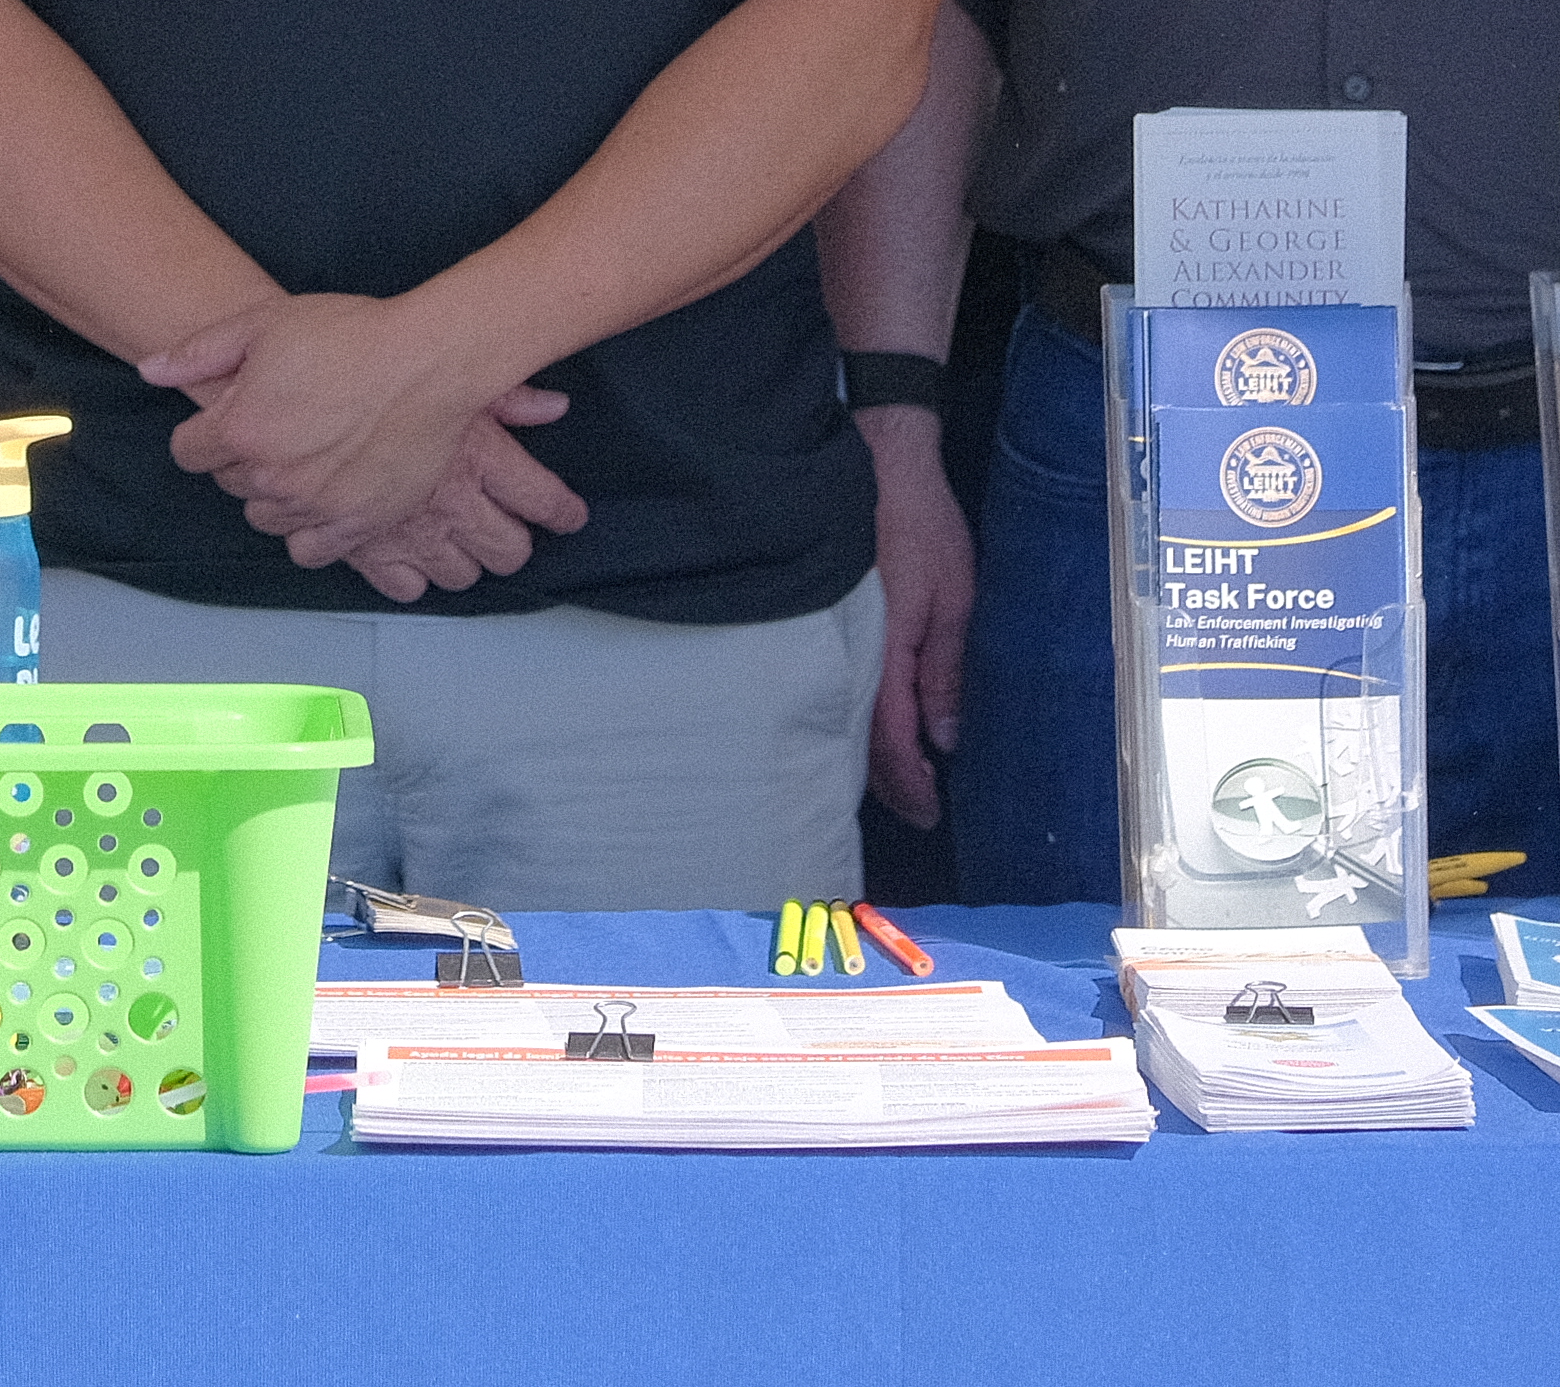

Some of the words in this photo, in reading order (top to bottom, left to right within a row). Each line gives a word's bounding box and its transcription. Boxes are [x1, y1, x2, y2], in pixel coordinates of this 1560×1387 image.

[1171, 197, 1347, 221] KATHARINE
[1169, 229, 1192, 253] &
[1209, 229, 1347, 252] GEORGE
[1172, 259, 1346, 283] ALEXANDER
[1171, 288, 1350, 308] COMMUNITY
[1165, 547, 1259, 575] LEIHT
[1165, 582, 1240, 610] Task
[1247, 582, 1335, 610] Force
[1165, 615, 1195, 630] Law
[1197, 614, 1288, 631] Enforcement
[1291, 614, 1384, 630] Investigating
[1165, 634, 1217, 649] Human
[1219, 633, 1298, 652] Trafficking
